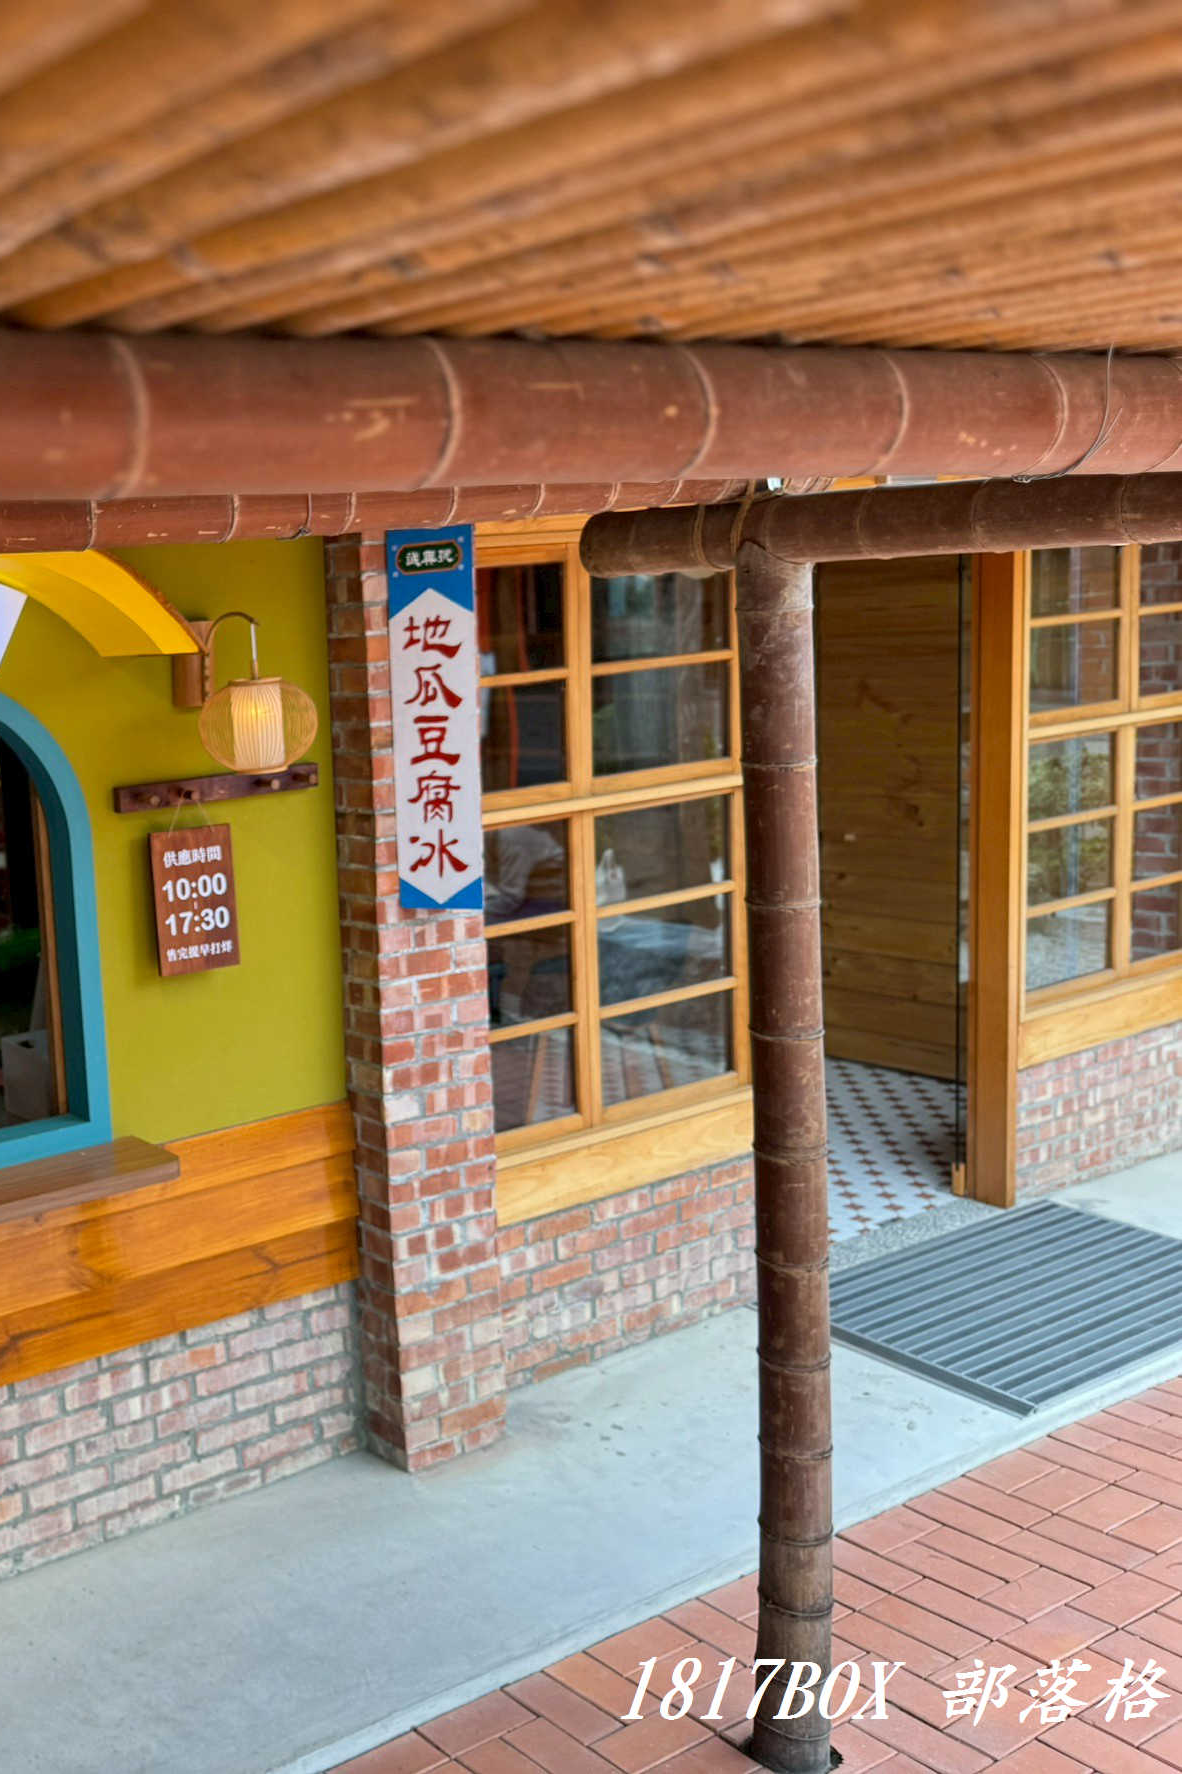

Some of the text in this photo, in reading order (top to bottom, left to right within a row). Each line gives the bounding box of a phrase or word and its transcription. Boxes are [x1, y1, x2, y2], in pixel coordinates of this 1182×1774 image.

[402, 613, 469, 878] 地瓜豆腐冰
[163, 845, 222, 868] 供應時間
[162, 872, 228, 902] 10:00
[165, 905, 231, 936] 17:30
[166, 939, 233, 962] 售完提早打烊
